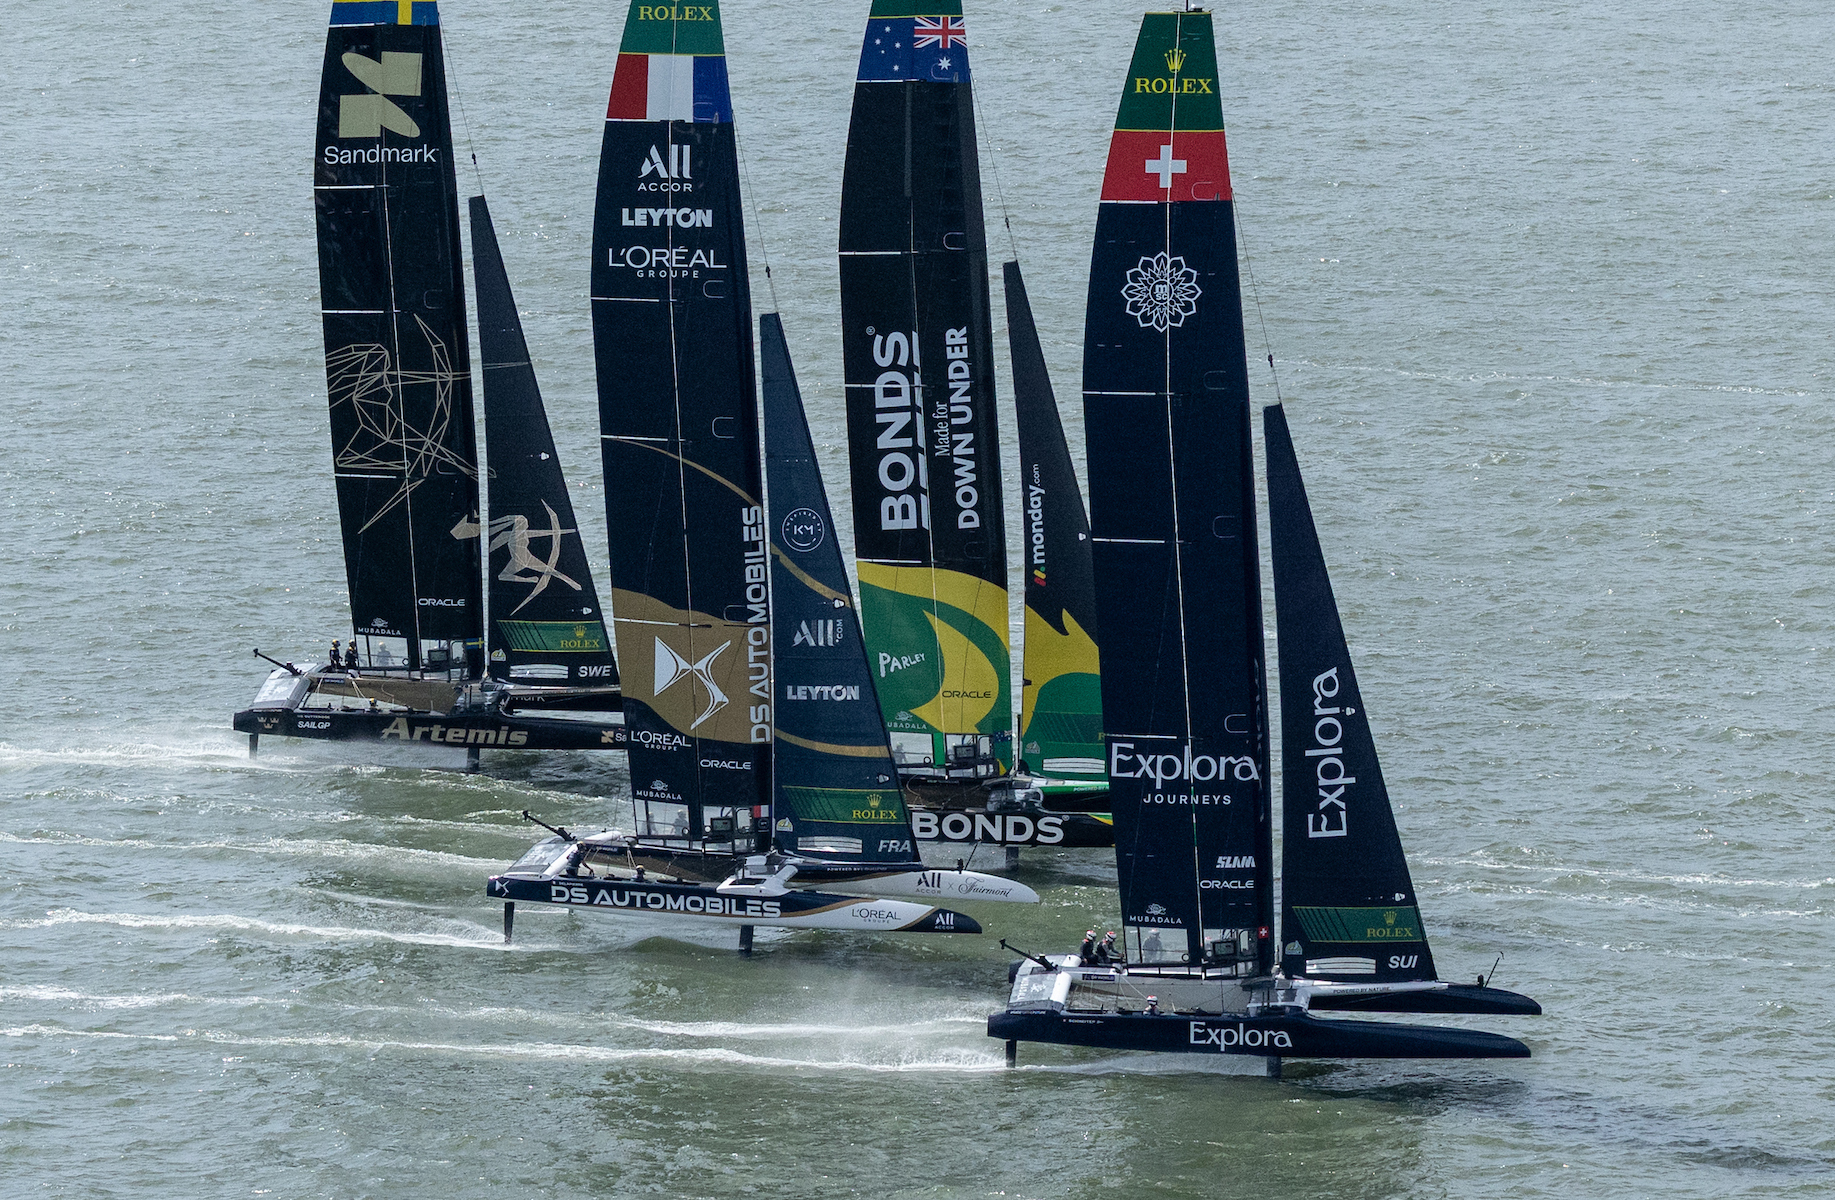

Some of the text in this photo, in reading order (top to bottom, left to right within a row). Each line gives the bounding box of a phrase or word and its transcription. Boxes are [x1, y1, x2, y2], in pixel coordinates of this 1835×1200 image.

[638, 6, 714, 21] ROLEX
[1134, 77, 1213, 94] ROLEX
[324, 144, 437, 164] Sandmark
[638, 182, 692, 192] ACCOR
[622, 207, 713, 228] LEYTON
[608, 245, 728, 268] L'ORÉAL
[636, 270, 700, 278] GROUPE
[932, 401, 951, 457] Made for
[945, 326, 981, 530] DOWN UNDER
[418, 598, 466, 607] ORACLE
[742, 506, 770, 744] DS AUTOMOBILES
[358, 627, 402, 636] MUBADALA
[560, 639, 600, 648] ROLEX
[578, 665, 612, 677] SWE
[878, 652, 926, 678] PARLEY
[786, 684, 860, 702] LEYTON
[942, 690, 992, 699] ORACLE
[298, 720, 330, 730] SAILGP
[887, 722, 927, 730] UBADALA
[381, 717, 528, 746] Artemis
[630, 730, 692, 747] L'ORÉAL
[644, 744, 678, 752] GROUPE
[1304, 666, 1356, 838] Explora
[700, 758, 751, 770] ORACLE
[1110, 742, 1260, 790] Explora
[636, 790, 682, 800] MUBADALA
[1143, 794, 1232, 805] JOURNEYS
[852, 810, 897, 820] ROLEX
[878, 840, 912, 852] FRA
[1215, 856, 1256, 868] SLAM
[958, 876, 1013, 898] Fairmont
[1200, 880, 1254, 889] ORACLE
[551, 886, 781, 918] DS AUTOMOBILES
[852, 908, 902, 920] L'ORÉAL
[1129, 914, 1182, 924] MUBADALA
[1366, 927, 1413, 938] ROLEX
[1388, 955, 1418, 969] SUI
[1189, 1021, 1293, 1052] Explora
